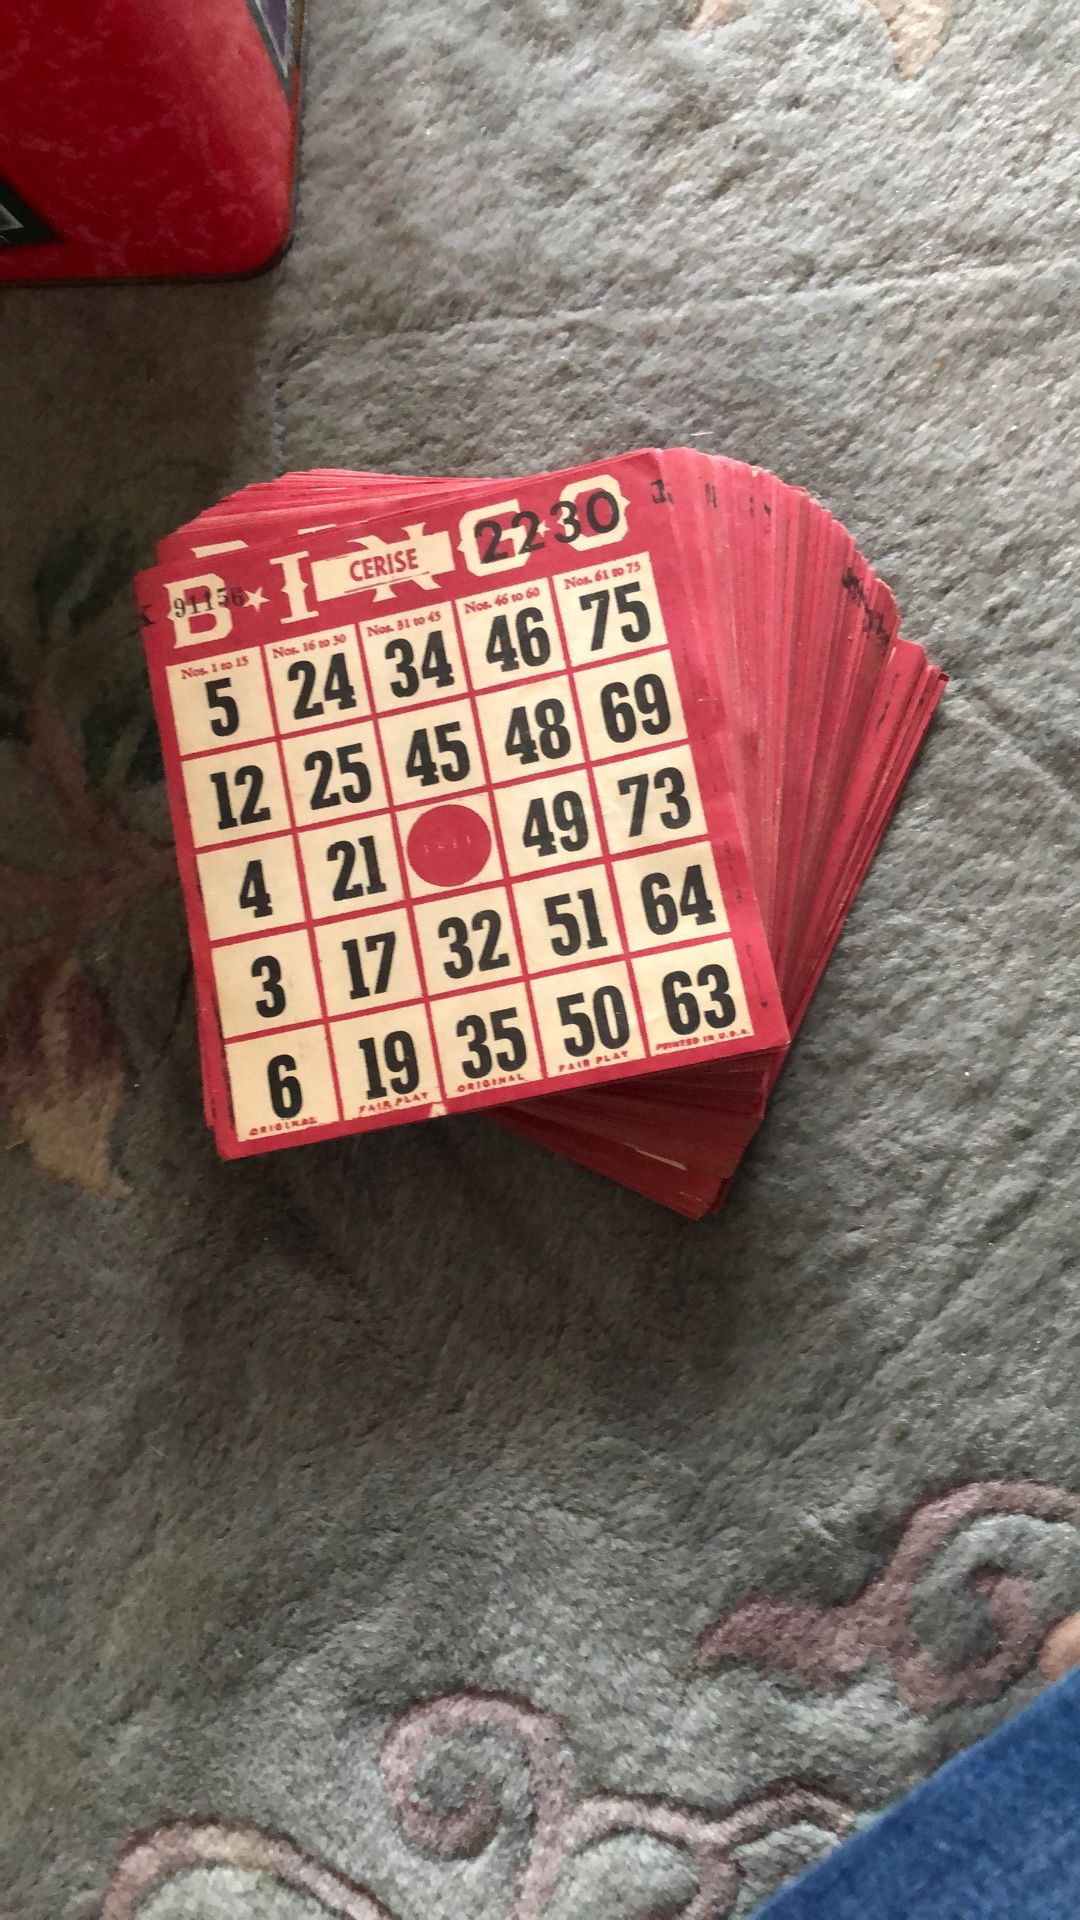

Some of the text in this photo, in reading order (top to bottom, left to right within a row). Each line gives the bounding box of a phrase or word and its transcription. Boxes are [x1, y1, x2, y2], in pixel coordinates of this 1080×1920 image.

[474, 490, 620, 564] 2230
[350, 548, 419, 582] CERISE
[563, 560, 641, 590] Nos. 61 to 75
[173, 587, 245, 618] 91156
[464, 586, 540, 614] Nos. 46 to 60
[366, 626, 395, 638] Nos.
[413, 616, 425, 627] to
[427, 611, 442, 623] 45
[205, 582, 650, 736] 5 24 34 46 75
[272, 633, 347, 660] Nos. 16 to 30
[181, 656, 249, 680] Nos. 1 to 15
[210, 674, 670, 829] 12 25 45 48 69
[240, 768, 690, 918] 4 21 49 73
[252, 865, 715, 1017] 3 17 32 51 64
[268, 964, 735, 1118] 6 19 35 50 63
[558, 1050, 630, 1073] FAIR PLAY
[457, 1073, 526, 1093] ORIGINAL
[358, 1091, 429, 1115] FAIR PLAY
[249, 1116, 319, 1137] ORIGINAL
